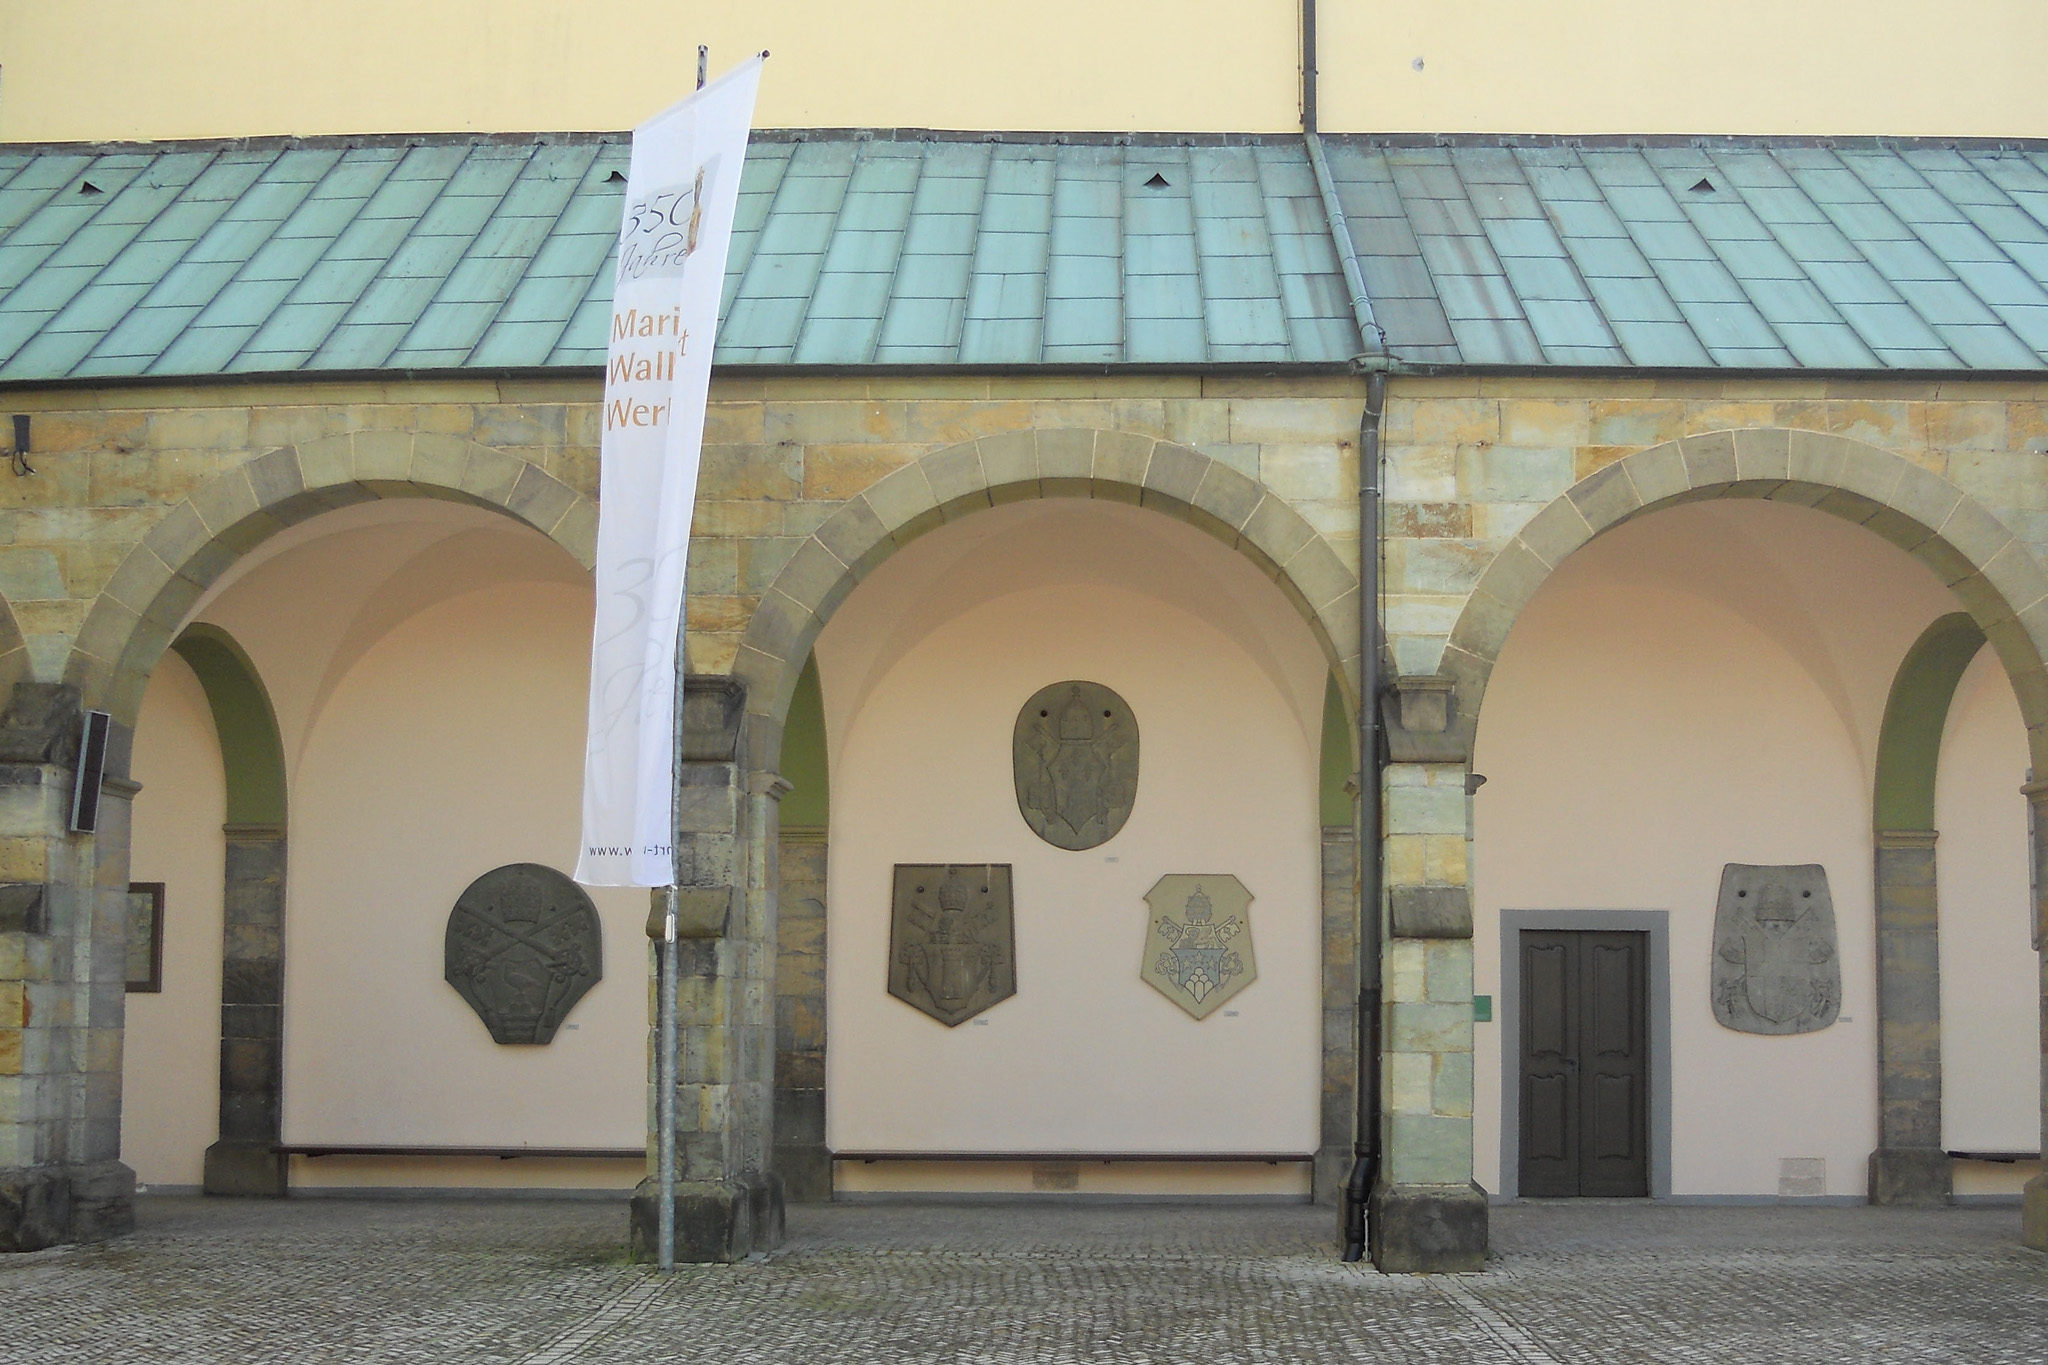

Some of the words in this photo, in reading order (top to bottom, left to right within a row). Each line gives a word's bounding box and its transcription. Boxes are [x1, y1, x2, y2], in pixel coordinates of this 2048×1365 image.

[616, 232, 687, 288] Jahre
[612, 306, 680, 343] Mari
[610, 351, 675, 387] Wall
